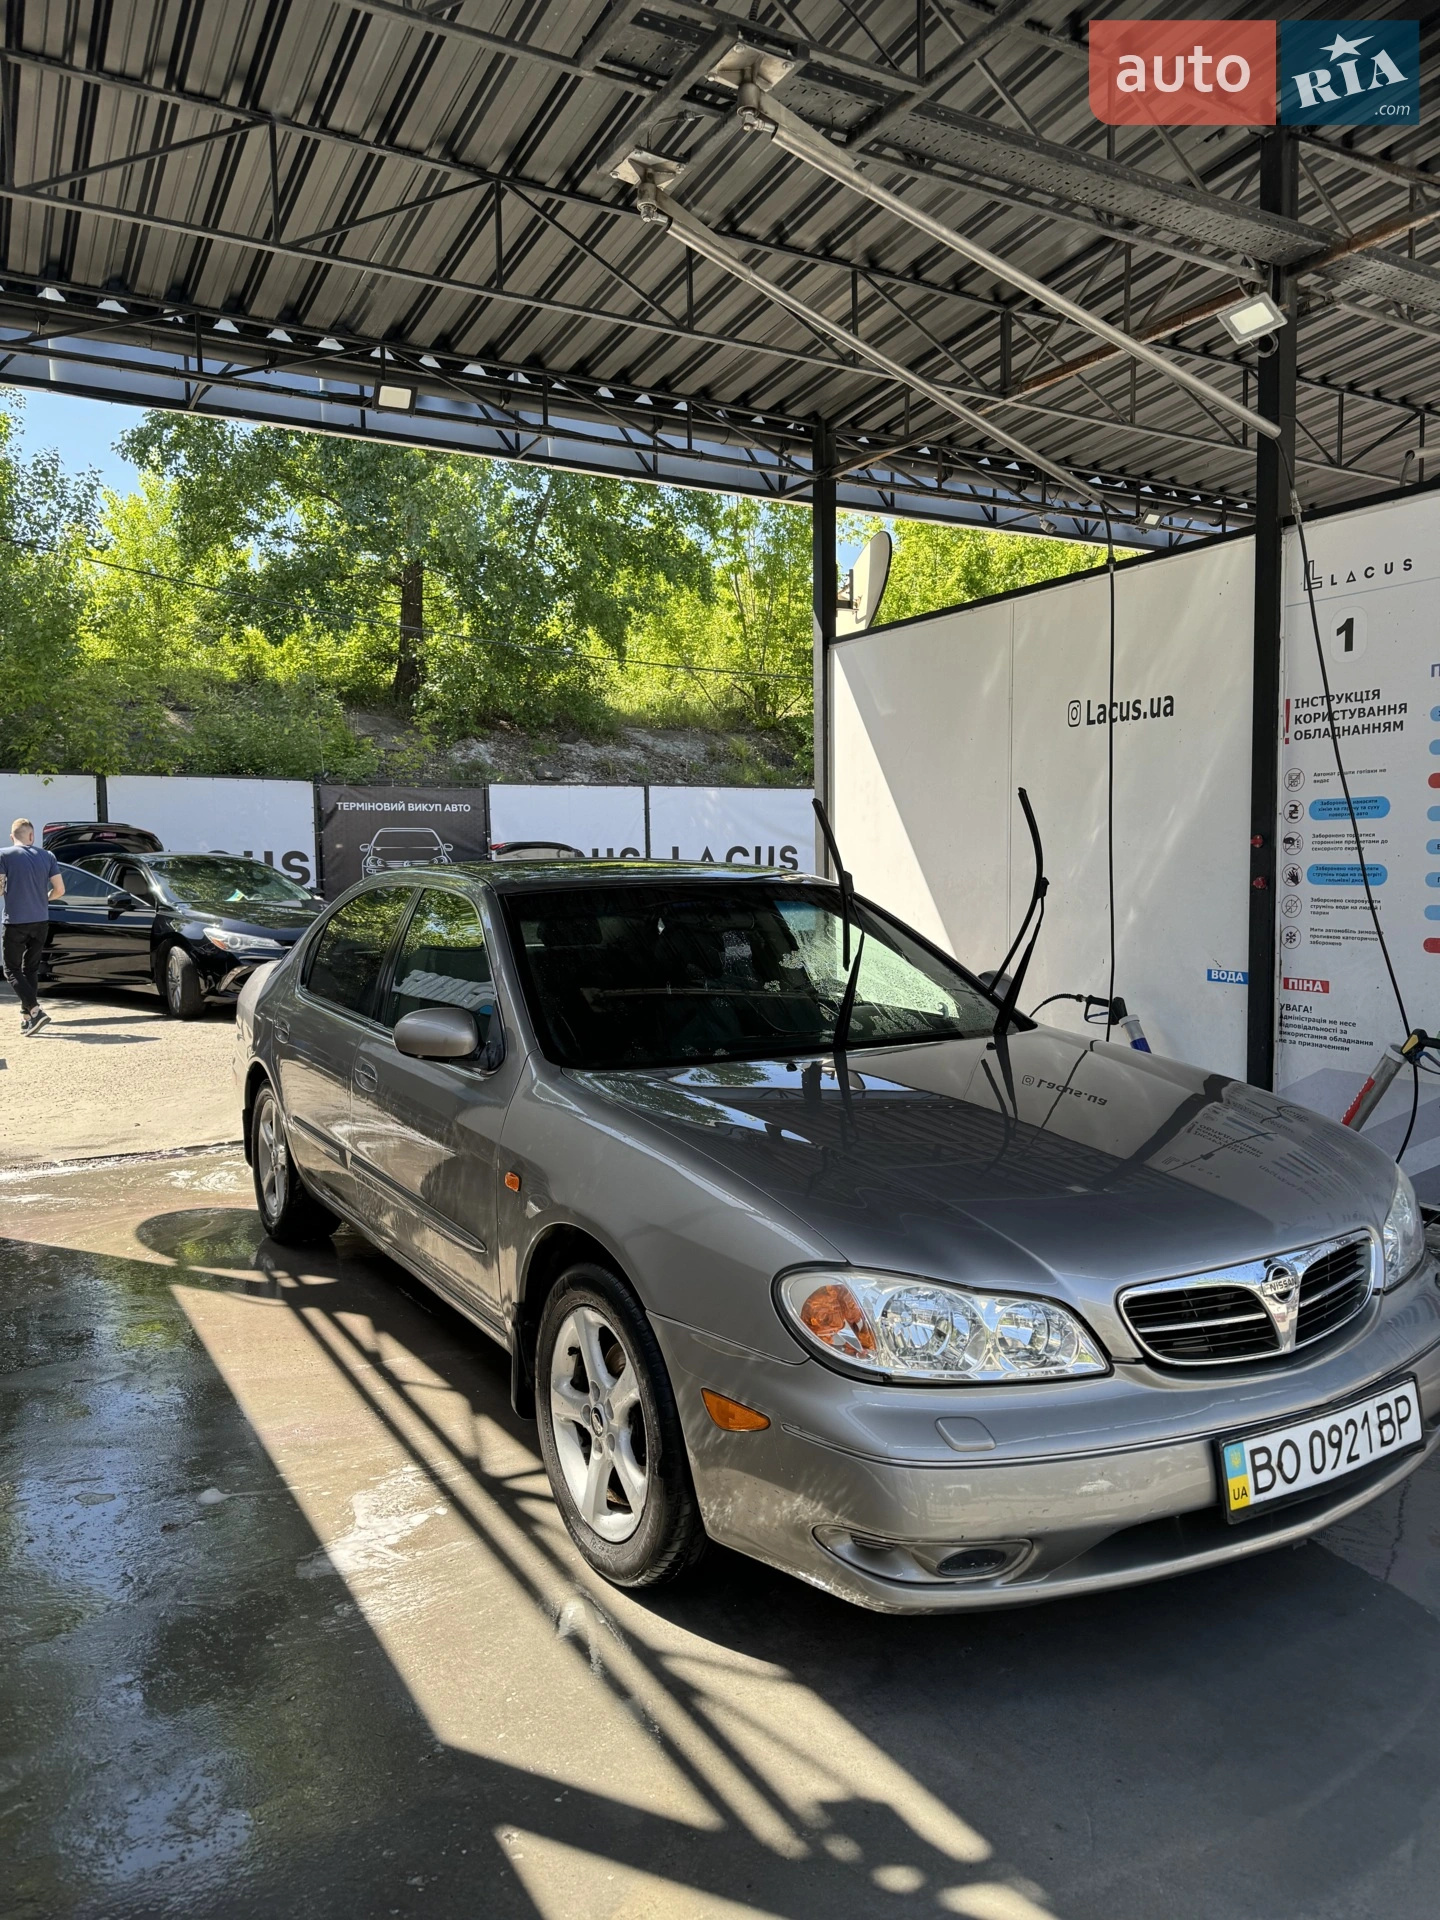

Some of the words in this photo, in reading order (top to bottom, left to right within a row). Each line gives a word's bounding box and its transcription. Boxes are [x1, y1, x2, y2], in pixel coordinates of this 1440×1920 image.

[1331, 558, 1413, 586] LACUS
[1336, 617, 1355, 653] 1
[1294, 688, 1381, 710] ІНСТРУКЦІЯ
[1086, 695, 1175, 726] Lacus.ua
[1294, 702, 1408, 726] КОРИСТУВАННЯ
[1293, 720, 1405, 741] ОБЛАДНАННЯМ
[336, 800, 406, 813] ТЕРМІНОВИЙ
[407, 802, 443, 813] ВИКУП
[444, 803, 472, 813] АВТО
[1210, 970, 1244, 983] ВОДА
[1288, 979, 1324, 992] ПІНА
[1280, 1003, 1313, 1014] УВАГА!
[1298, 1040, 1350, 1052] призначенням
[1329, 1035, 1374, 1047] обладнання
[1249, 1438, 1301, 1496] BO
[1309, 1410, 1374, 1475] 0921
[1376, 1394, 1412, 1448] BP
[1232, 1486, 1248, 1501] UA
